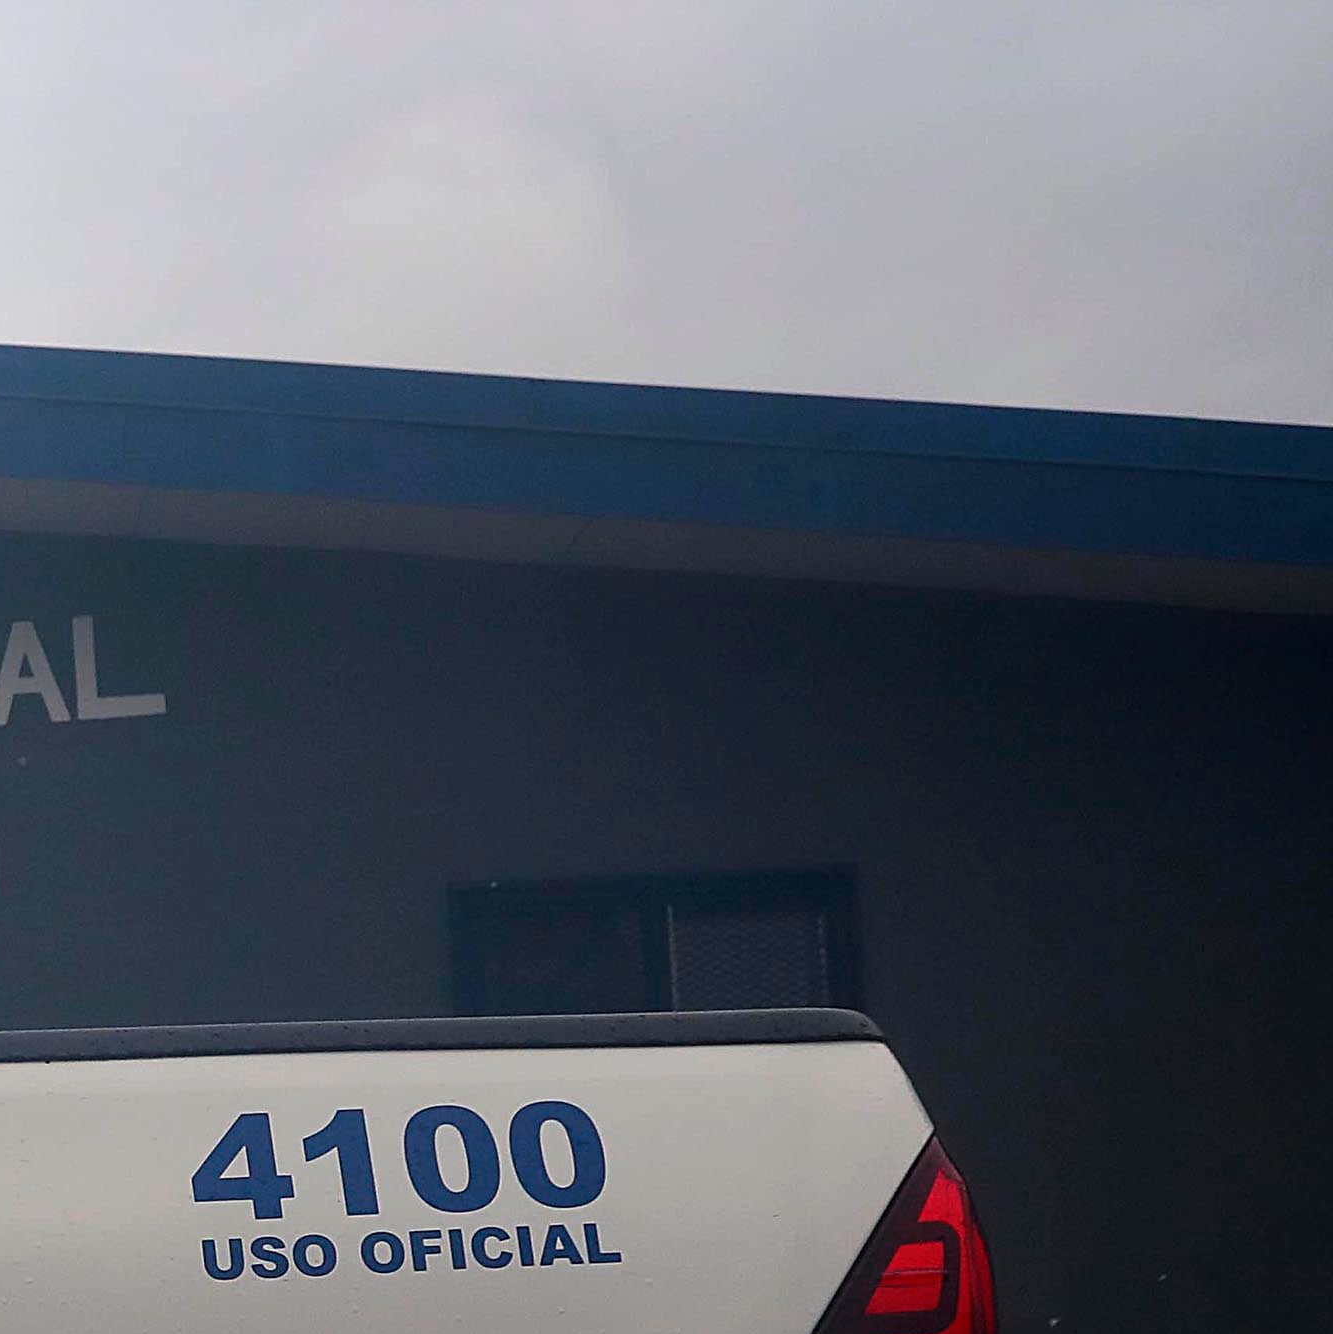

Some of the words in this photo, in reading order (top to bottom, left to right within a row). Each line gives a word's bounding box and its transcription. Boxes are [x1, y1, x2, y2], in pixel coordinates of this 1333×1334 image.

[191, 1101, 606, 1220] 4100
[202, 1234, 337, 1281] USO
[360, 1223, 622, 1275] OFICIAL
